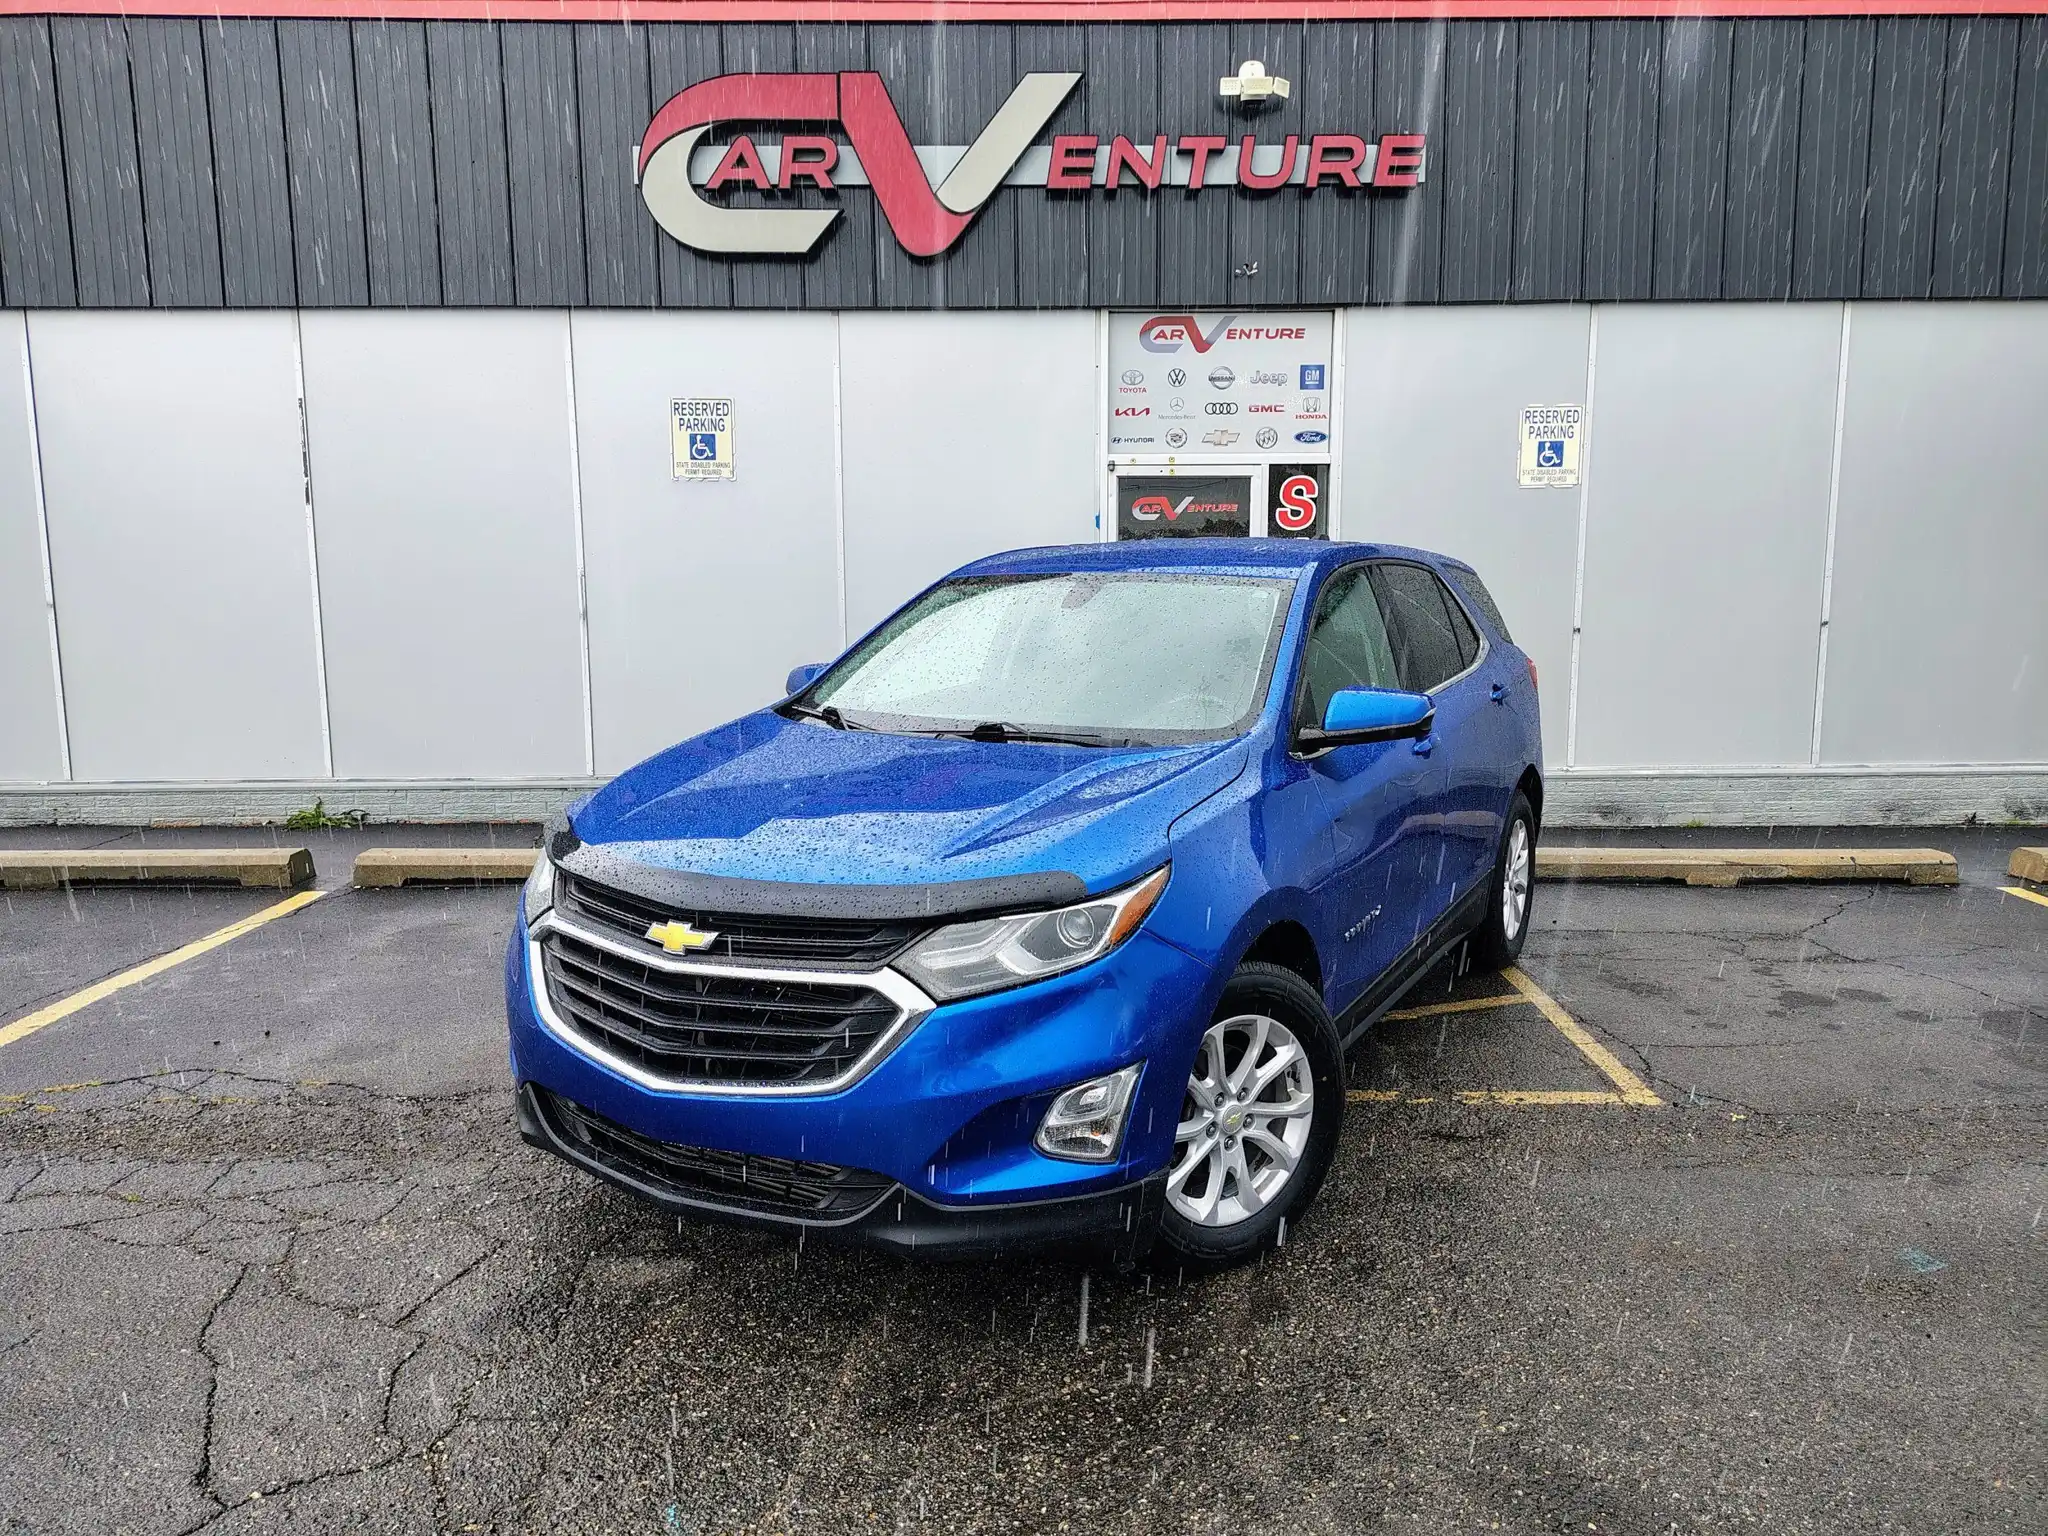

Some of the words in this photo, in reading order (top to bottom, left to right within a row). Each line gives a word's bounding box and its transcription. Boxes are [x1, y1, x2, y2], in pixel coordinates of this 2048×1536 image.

[1250, 370, 1288, 386] Jeep
[1304, 369, 1320, 381] GM
[673, 402, 730, 417] RESERVED
[1248, 404, 1286, 413] GMC
[1524, 410, 1580, 424] RESERVED
[679, 418, 726, 432] PARKING
[1300, 431, 1322, 442] Ford
[1528, 425, 1575, 440] PARKING
[1275, 475, 1319, 531] S
